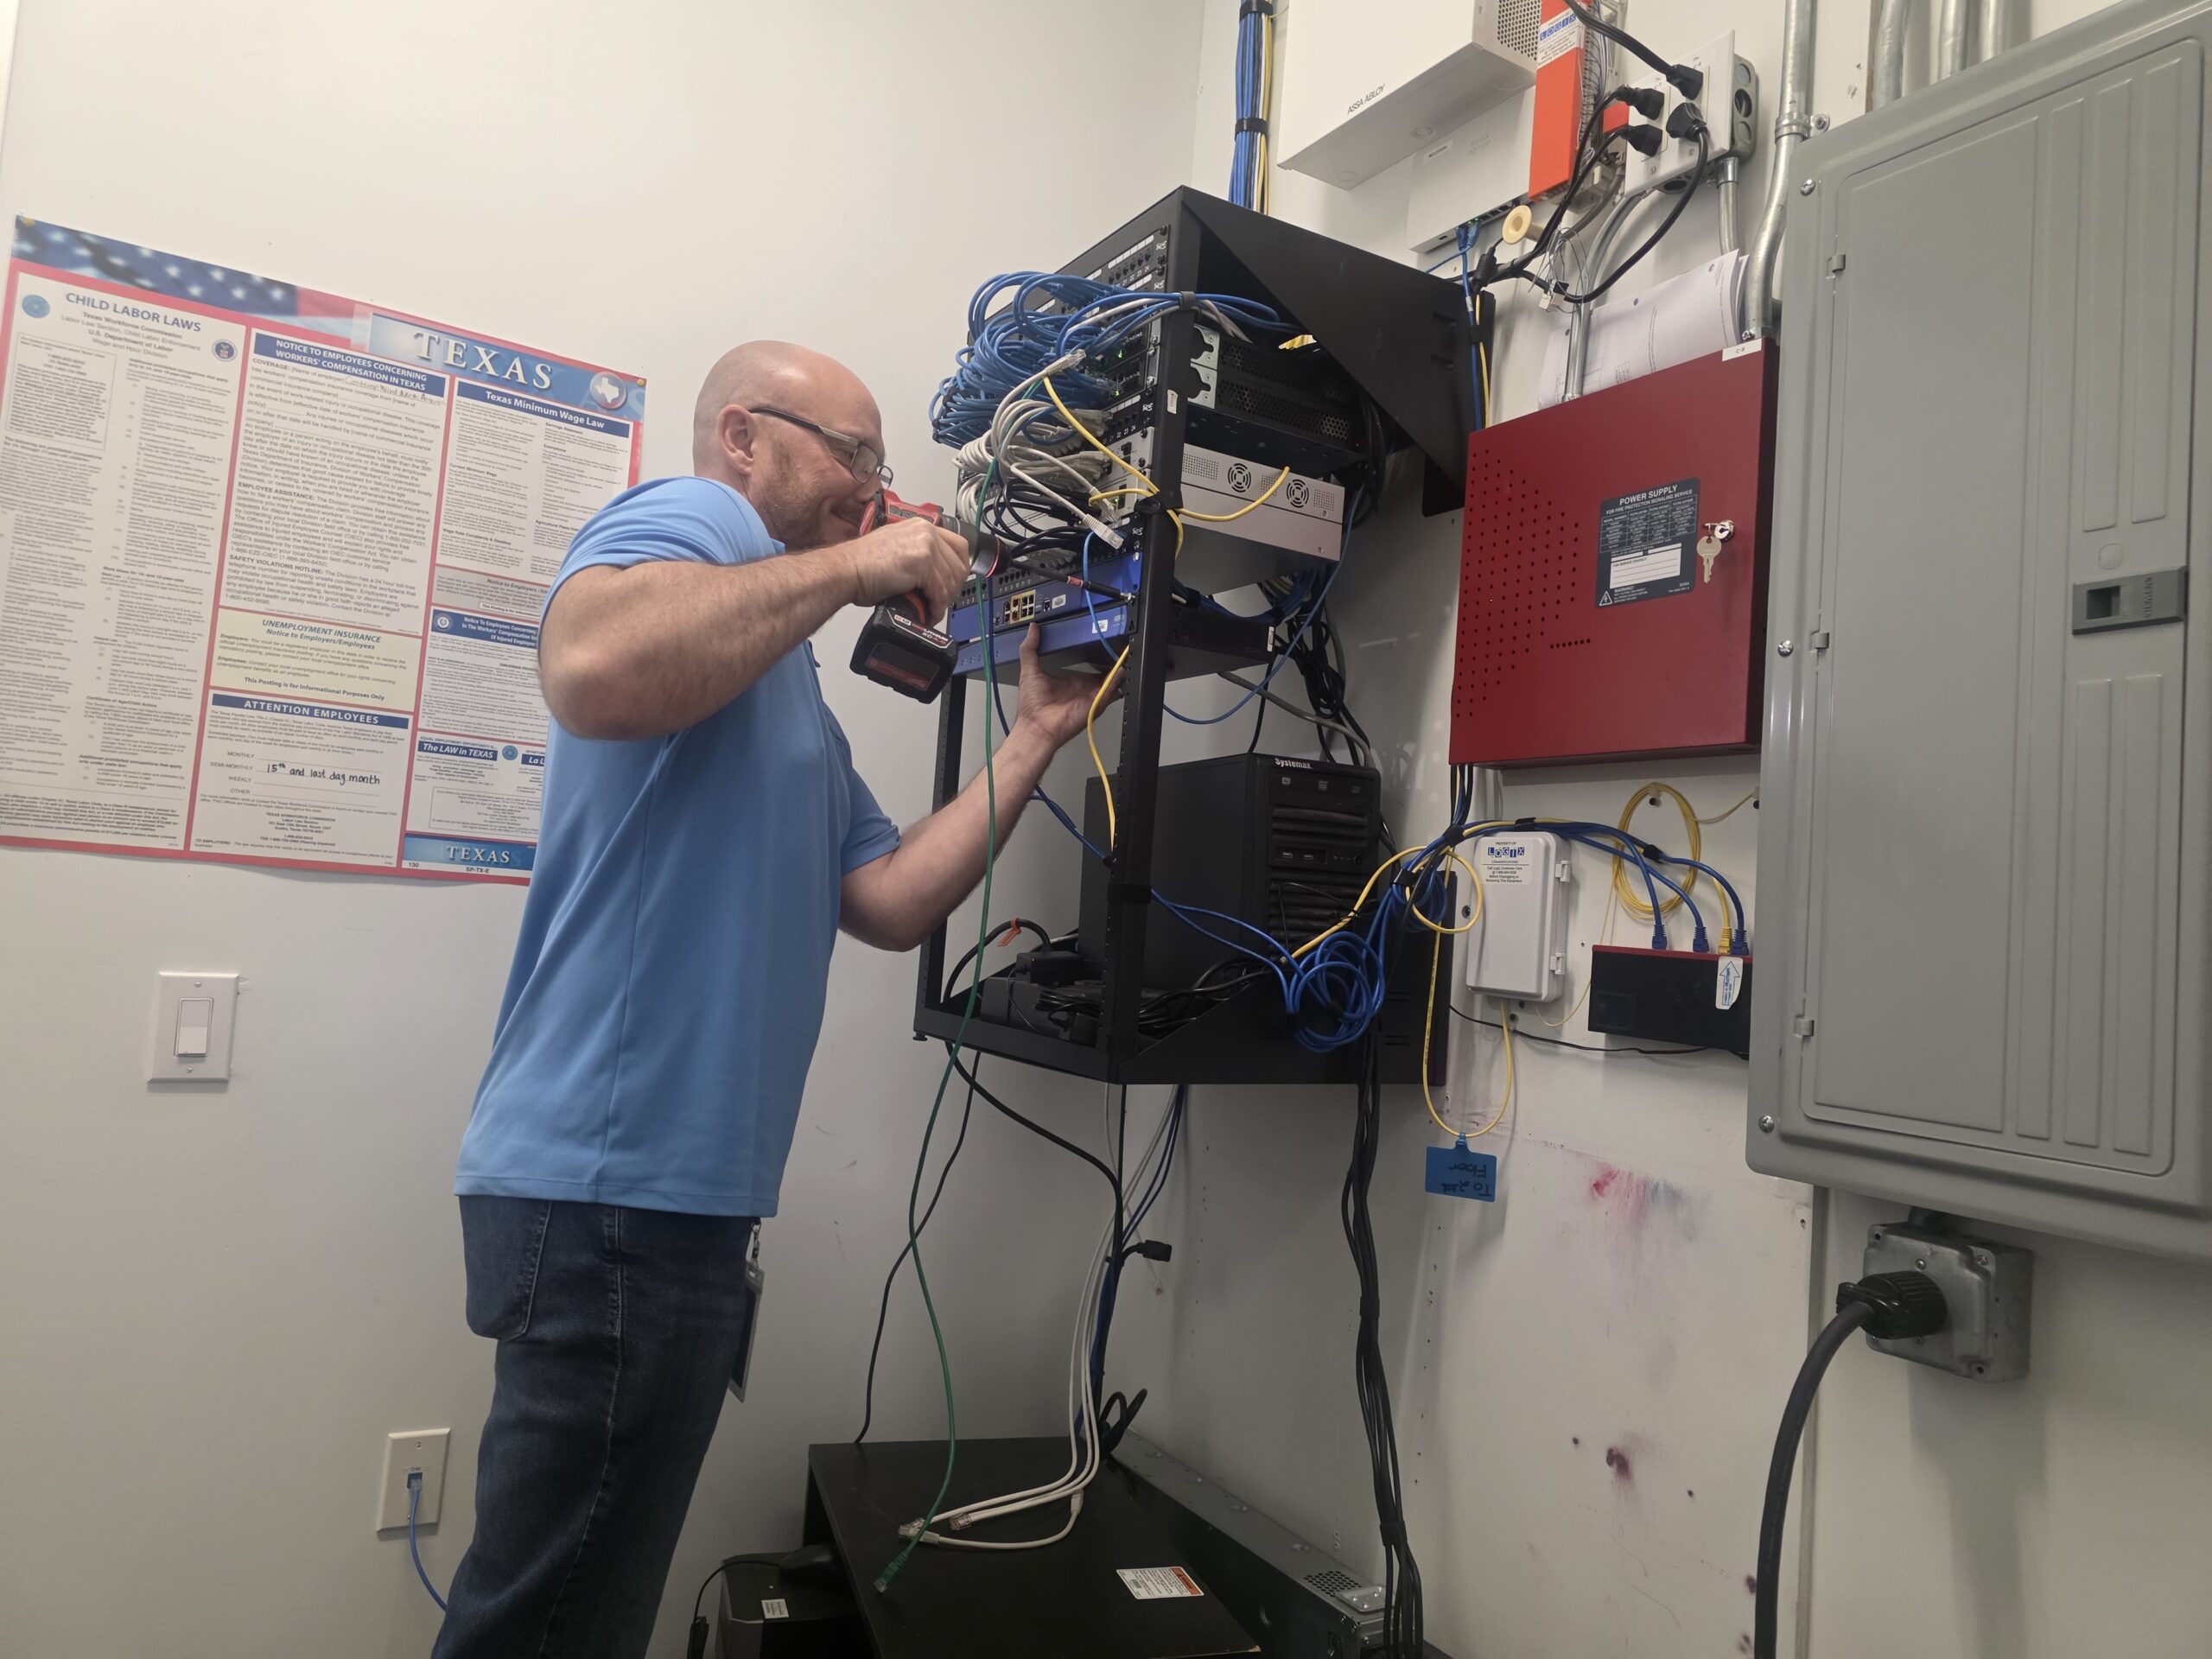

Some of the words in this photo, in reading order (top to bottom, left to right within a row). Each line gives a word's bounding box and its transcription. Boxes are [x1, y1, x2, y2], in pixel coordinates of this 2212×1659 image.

[1540, 13, 1576, 41] LOGIX
[1347, 99, 1363, 114] ASSA
[1364, 83, 1385, 104] ABLOY
[65, 292, 109, 310] CHILD
[113, 303, 160, 322] LABOR
[163, 315, 200, 331] LAWS
[60, 314, 80, 323] Labor
[96, 322, 121, 333] Section,
[123, 329, 140, 337] Child
[161, 337, 200, 351] Enforcement
[82, 311, 102, 321] Texas
[104, 316, 139, 329] Workforce
[140, 325, 182, 339] Commission
[91, 337, 110, 346] Wage
[142, 348, 167, 358] Division
[104, 332, 143, 345] Department
[252, 357, 290, 370] COVERAGE:
[317, 373, 344, 383] employer]
[275, 349, 320, 365] WORKERS'
[321, 360, 388, 381] COMPENSATION
[399, 378, 425, 390] TEXAS
[276, 339, 308, 353] NOTICE
[309, 347, 321, 355] TO
[322, 350, 371, 367] EMPLOYEES
[373, 362, 426, 381] CONCERNING
[413, 332, 553, 389] TEXAS
[485, 391, 511, 404] Texas
[513, 398, 557, 416] Minimum
[559, 410, 584, 423] Wage
[586, 417, 604, 428] Law
[238, 481, 272, 492] EMPLOYEE
[273, 488, 314, 500] ASSISTANCE:
[1620, 493, 1647, 506] POWER
[1648, 485, 1678, 498] SUPPLY
[1625, 501, 1650, 510] PROTECTION
[1651, 495, 1673, 504] SIGNALING
[1674, 489, 1692, 498] SERVICE
[229, 554, 254, 562] SAFETY
[256, 559, 293, 569] VIOLATIONS
[294, 565, 323, 574] HOTLINE:
[510, 583, 536, 592] Employers
[262, 619, 333, 635] UNEMPLOYMENT
[334, 630, 381, 643] INSURANCE
[266, 628, 289, 637] Notice
[299, 633, 374, 649] Employers/Employees
[485, 620, 510, 629] Employees
[510, 625, 536, 636] Concerning
[498, 629, 530, 638] Compensation
[258, 678, 282, 687] Posting
[299, 684, 341, 694] Informational
[342, 689, 369, 698] Purposes
[244, 700, 309, 715] ATTENTION
[313, 708, 378, 723] EMPLOYEES
[423, 743, 438, 751] The
[439, 745, 458, 753] LAW
[469, 748, 493, 758] TEXAS
[210, 761, 252, 769] SEMI-MONTHLY
[267, 762, 286, 773] 15th
[290, 767, 305, 777] and
[310, 769, 326, 779] last
[349, 774, 380, 784] month
[1275, 758, 1312, 769] Systemax
[446, 845, 510, 863] TEXAS
[1488, 847, 1525, 857] LOGIX
[1448, 1163, 1487, 1178] Floor
[1473, 1182, 1491, 1197] To
